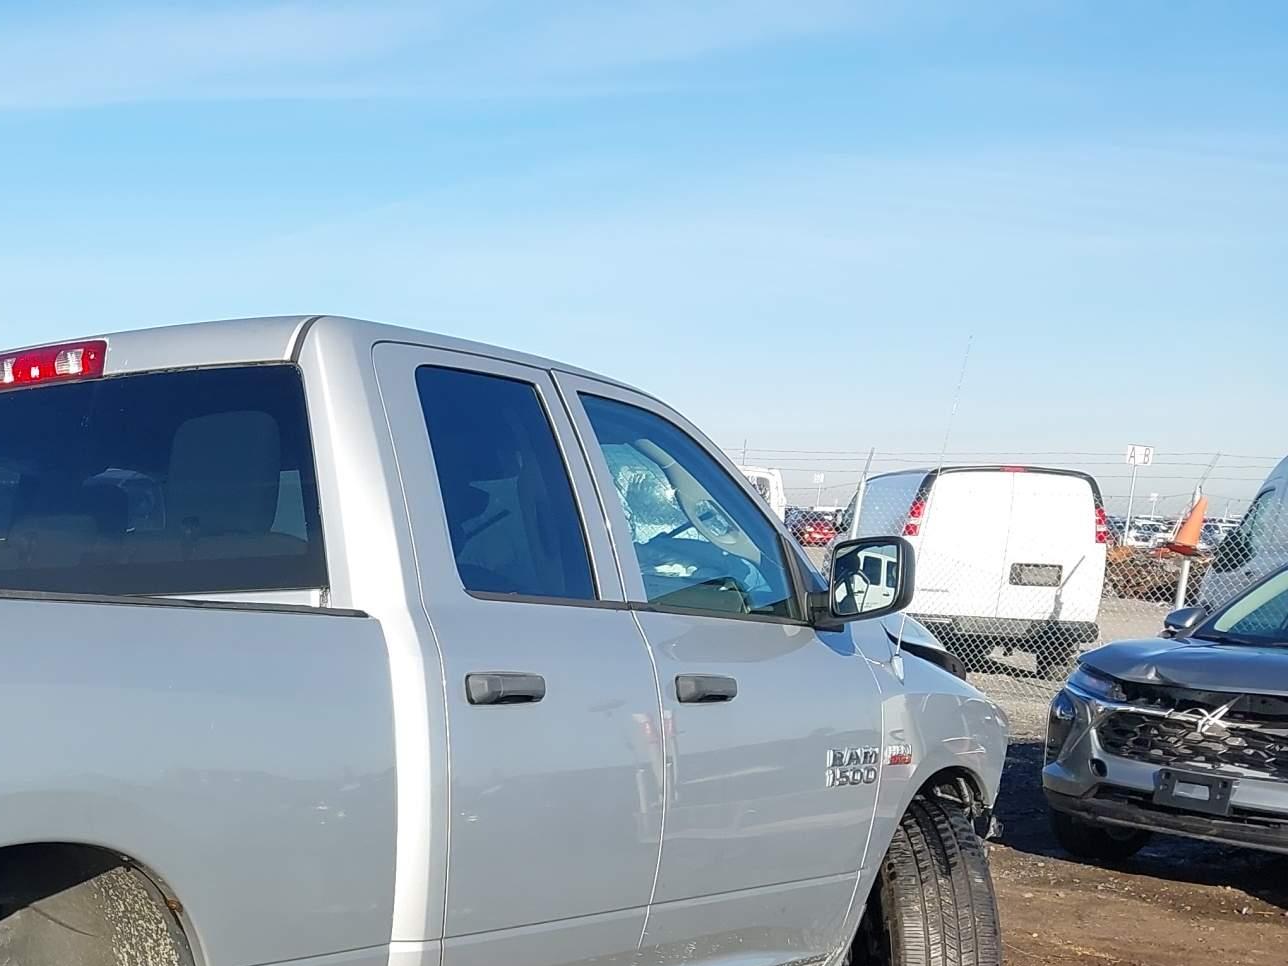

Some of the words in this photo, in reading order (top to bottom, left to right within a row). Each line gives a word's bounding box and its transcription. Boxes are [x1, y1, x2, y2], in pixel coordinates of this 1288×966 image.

[1128, 446, 1136, 464] A
[1143, 447, 1151, 465] B
[826, 746, 880, 767] RAM
[825, 766, 878, 787] 1500
